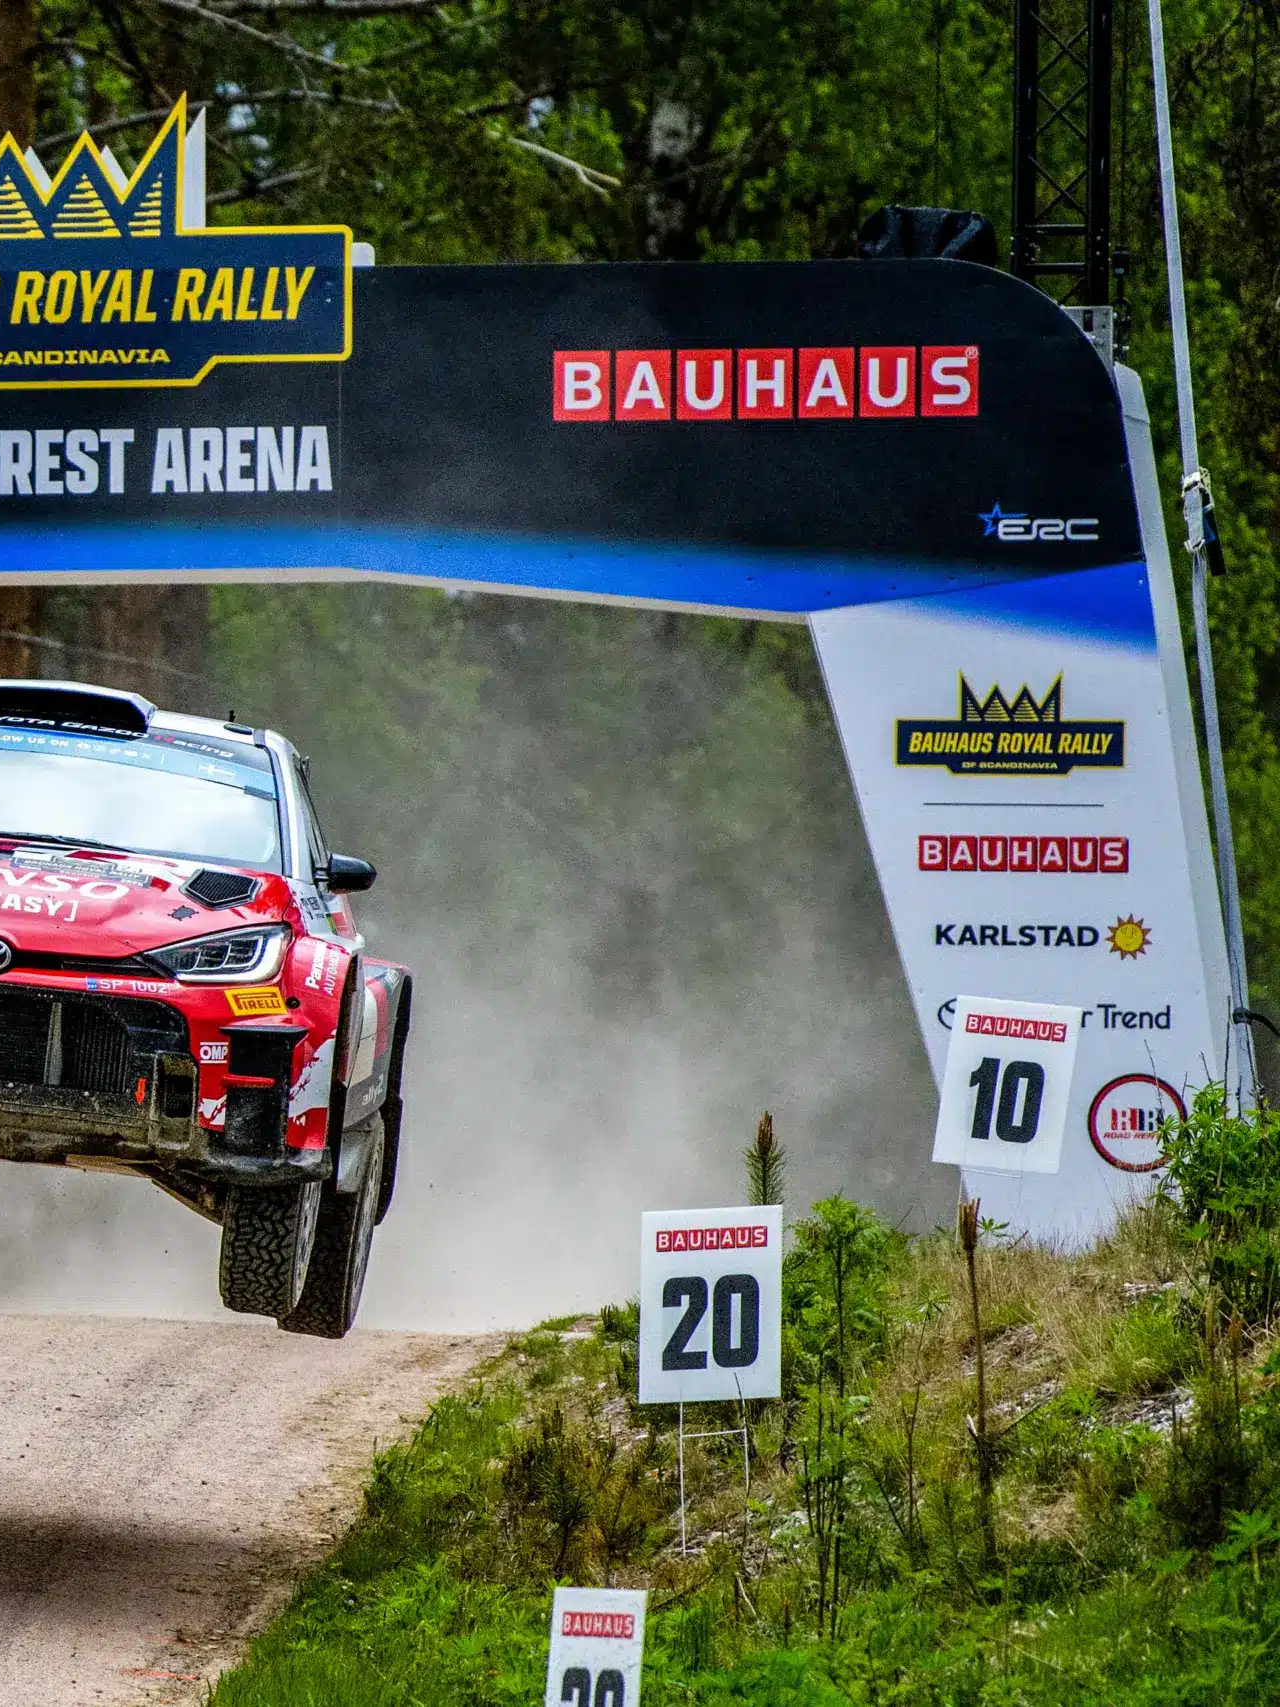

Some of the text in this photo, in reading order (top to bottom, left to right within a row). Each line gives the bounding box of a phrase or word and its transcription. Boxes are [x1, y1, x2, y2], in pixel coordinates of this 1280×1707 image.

[10, 270, 157, 324] ROYAL
[173, 266, 315, 322] RALLY
[562, 357, 973, 410] BAUHAUS
[151, 426, 333, 492] ARENA
[997, 519, 1099, 541] ERC
[61, 721, 149, 738] GAZOO
[909, 732, 1113, 755] BAUHAUS ROYAL RALLY
[922, 840, 1124, 867] BAUHAUS
[935, 924, 1100, 947] KARLSTAD
[99, 980, 168, 994] SP 1002
[232, 992, 282, 1010] PIRELLI
[968, 1016, 1066, 1039] BAUHAUS
[1097, 1004, 1171, 1029] Trend
[200, 1045, 228, 1060] OMP
[969, 1057, 1046, 1143] 10
[658, 1226, 768, 1250] BAUHAUS
[662, 1273, 760, 1371] 20
[563, 1613, 634, 1637] BAUHAUS
